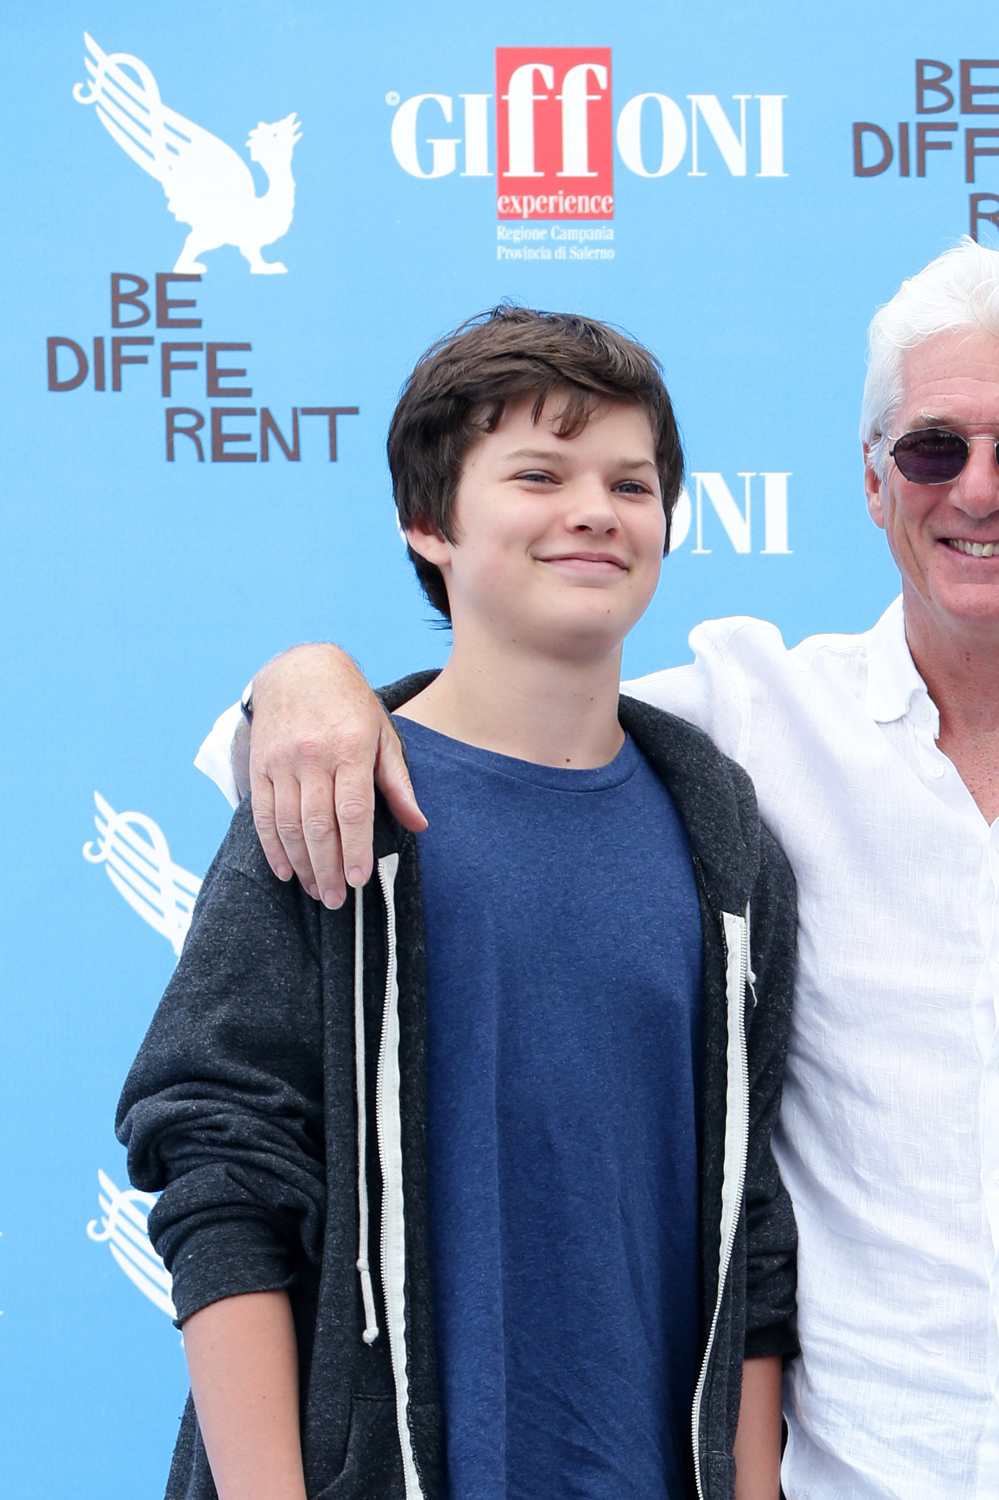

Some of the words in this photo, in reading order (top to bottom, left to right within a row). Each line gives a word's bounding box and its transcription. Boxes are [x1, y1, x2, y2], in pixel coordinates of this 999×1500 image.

[497, 190, 614, 219] experience
[496, 246, 552, 260] Provincia
[554, 246, 567, 260] di
[569, 246, 616, 260] Salerno
[497, 225, 548, 243] Regione
[550, 225, 615, 243] Campania
[111, 274, 203, 329] BE
[47, 337, 253, 398] DIFFE
[166, 407, 359, 463] RENT
